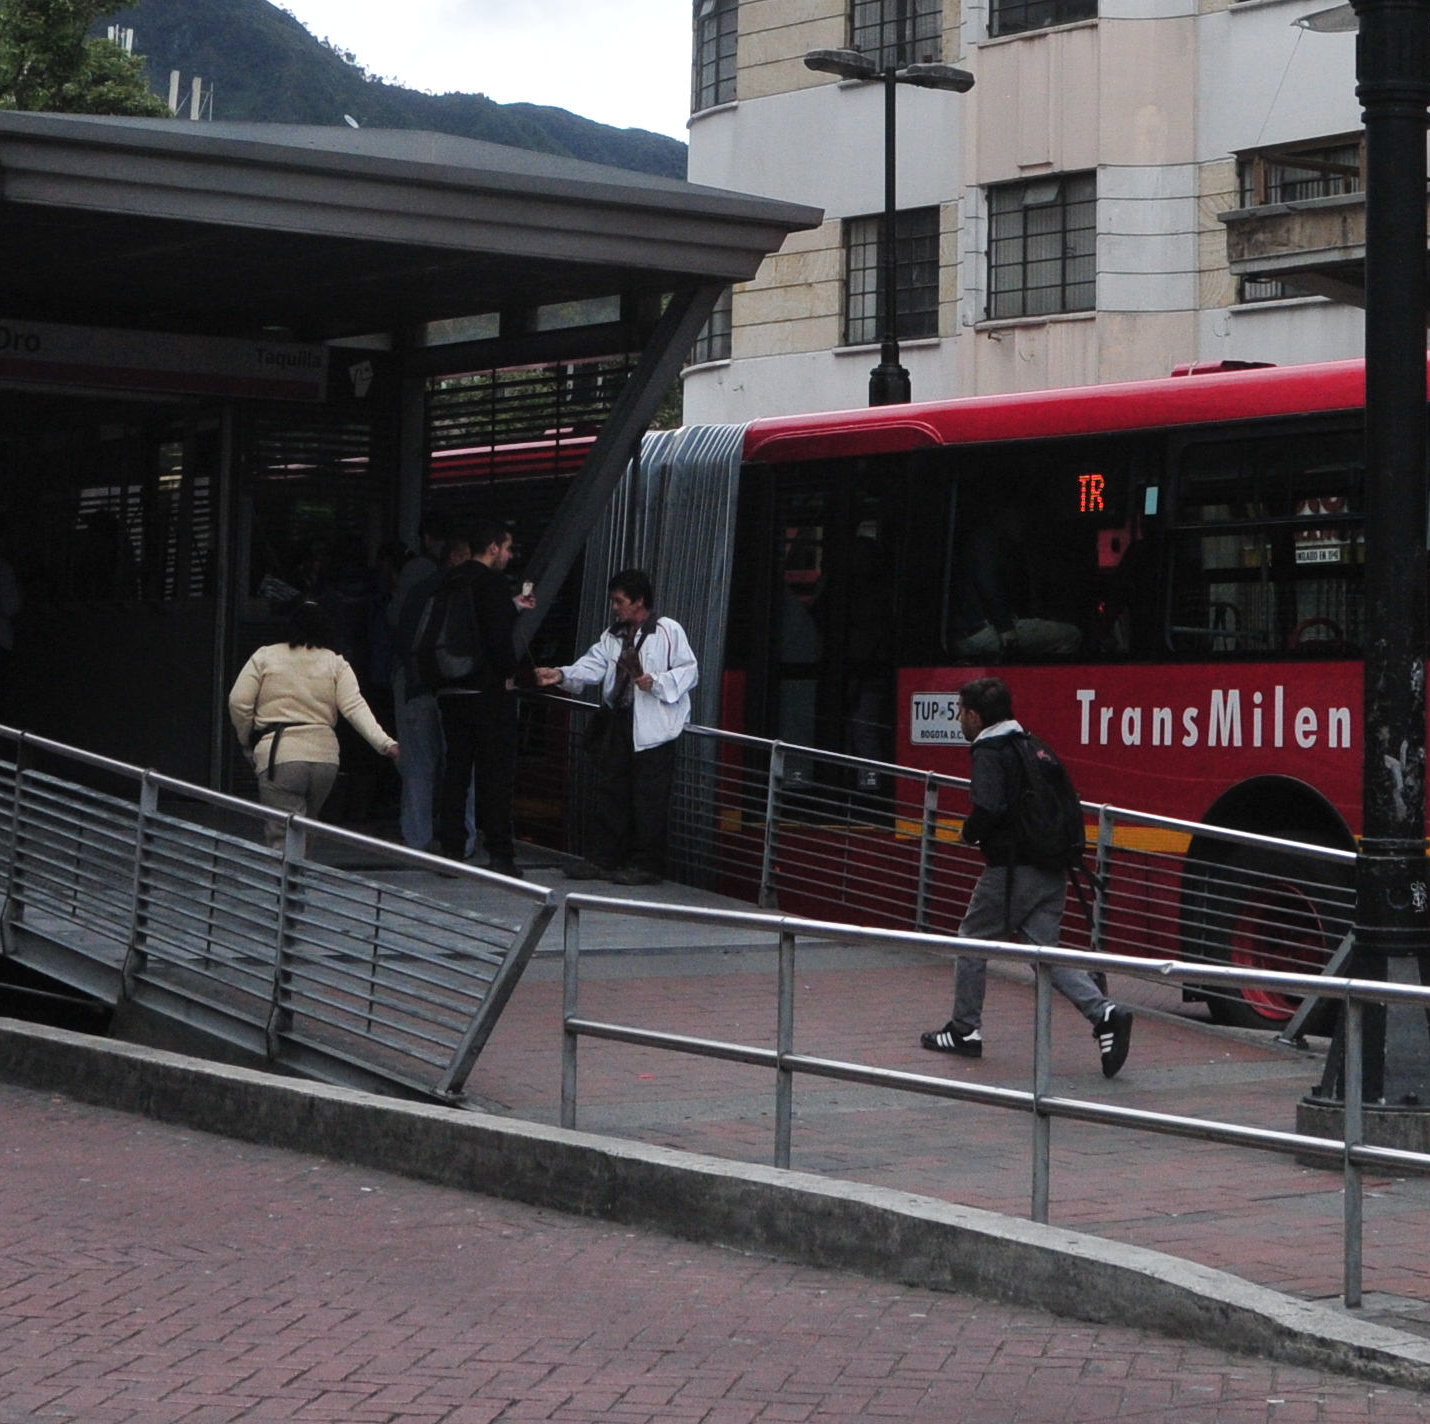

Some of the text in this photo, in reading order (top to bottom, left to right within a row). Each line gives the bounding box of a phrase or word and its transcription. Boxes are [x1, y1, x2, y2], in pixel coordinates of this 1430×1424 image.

[255, 348, 321, 370] Taquilla
[1078, 474, 1105, 512] TR
[913, 701, 939, 720] TUP
[1076, 685, 1351, 749] TransMilen
[920, 730, 949, 739] BOGOTA
